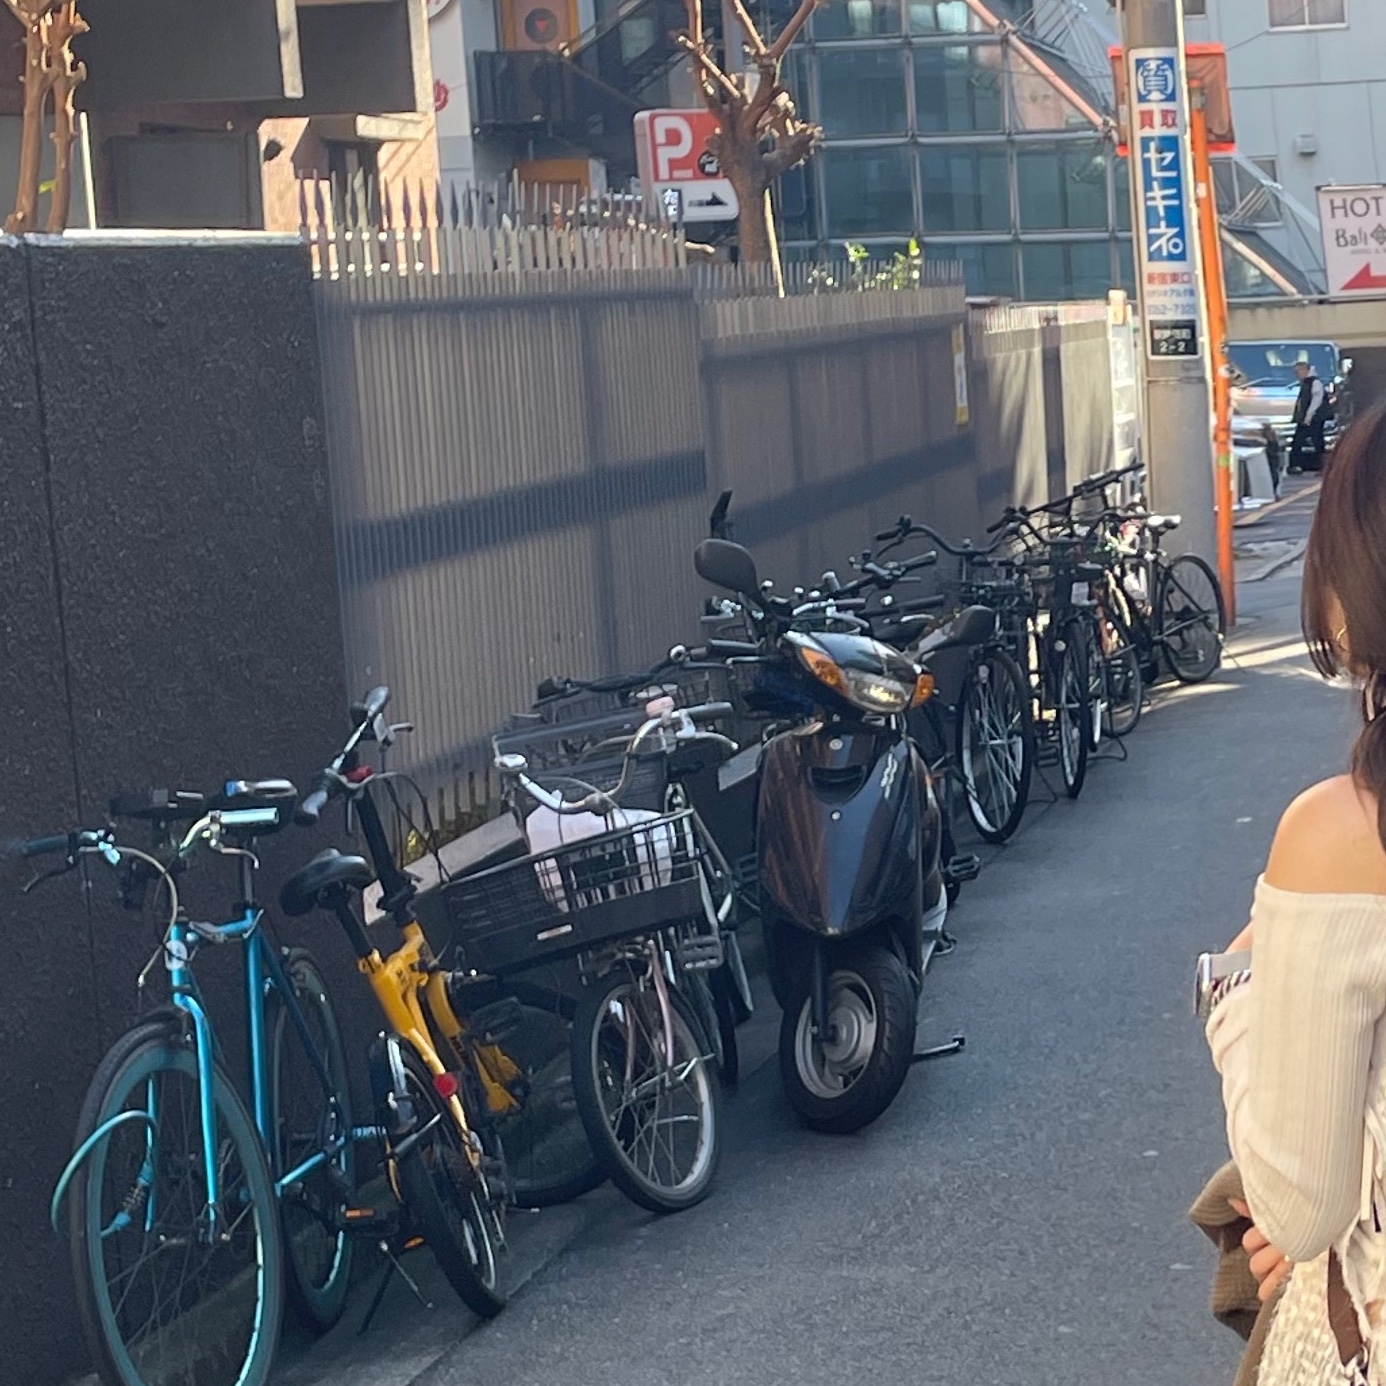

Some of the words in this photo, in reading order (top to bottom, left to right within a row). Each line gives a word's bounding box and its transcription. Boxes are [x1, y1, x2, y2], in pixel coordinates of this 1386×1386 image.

[1139, 109, 1178, 130] 買取
[1335, 227, 1368, 247] Bali
[1160, 341, 1187, 353] 2-2
